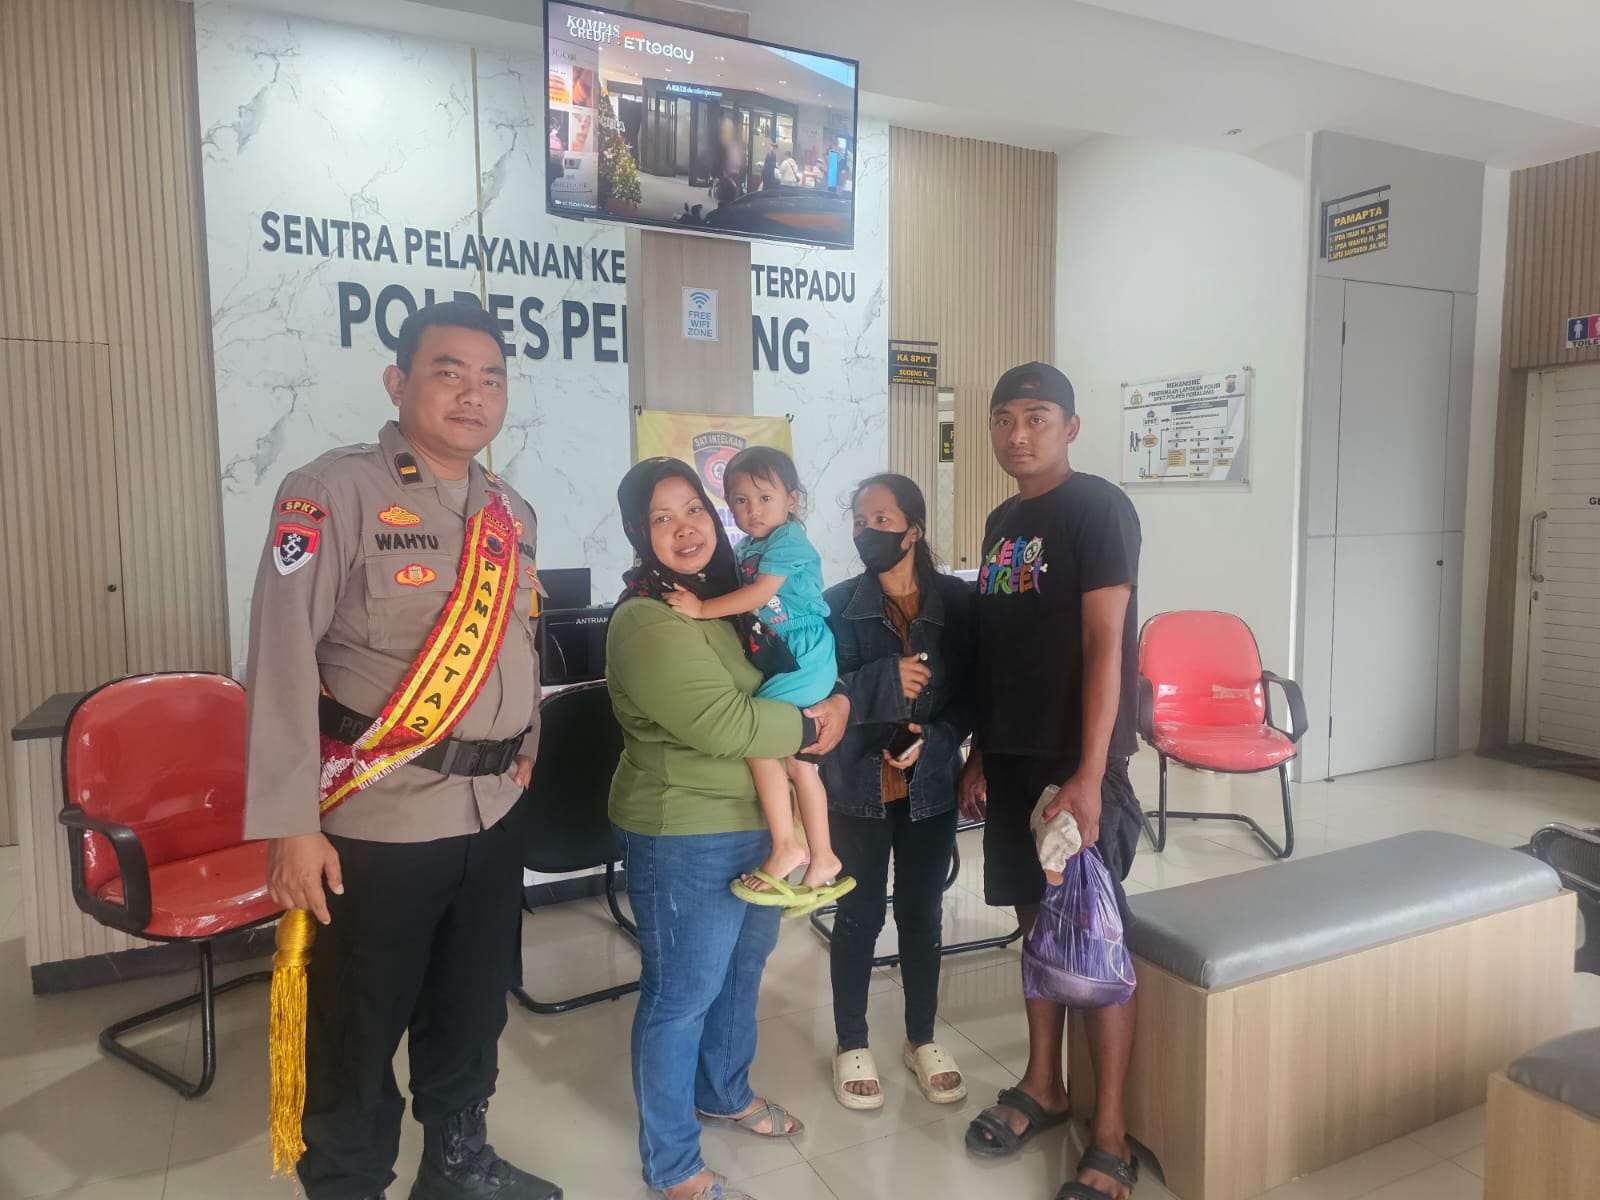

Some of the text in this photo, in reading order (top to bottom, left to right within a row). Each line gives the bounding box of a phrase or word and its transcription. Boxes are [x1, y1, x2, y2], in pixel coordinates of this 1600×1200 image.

[567, 15, 621, 38] KOMPAS
[570, 26, 612, 43] CREDIT
[624, 36, 694, 64] ETtoday
[1334, 207, 1382, 227] PAMAPTA
[261, 210, 399, 264] SENTRA
[404, 227, 584, 280] PELAYANAN
[751, 264, 856, 304] TERPADU
[338, 281, 550, 360] POES
[688, 311, 712, 320] FREE
[687, 328, 713, 338] ZONE
[690, 320, 710, 329] WIFI
[1573, 339, 1599, 347] TOILE
[897, 353, 932, 364] KA SPKT
[1166, 379, 1201, 389] MEKANISME
[286, 501, 318, 515] SPKT
[375, 533, 439, 550] WAHYU
[411, 716, 429, 733] 2
